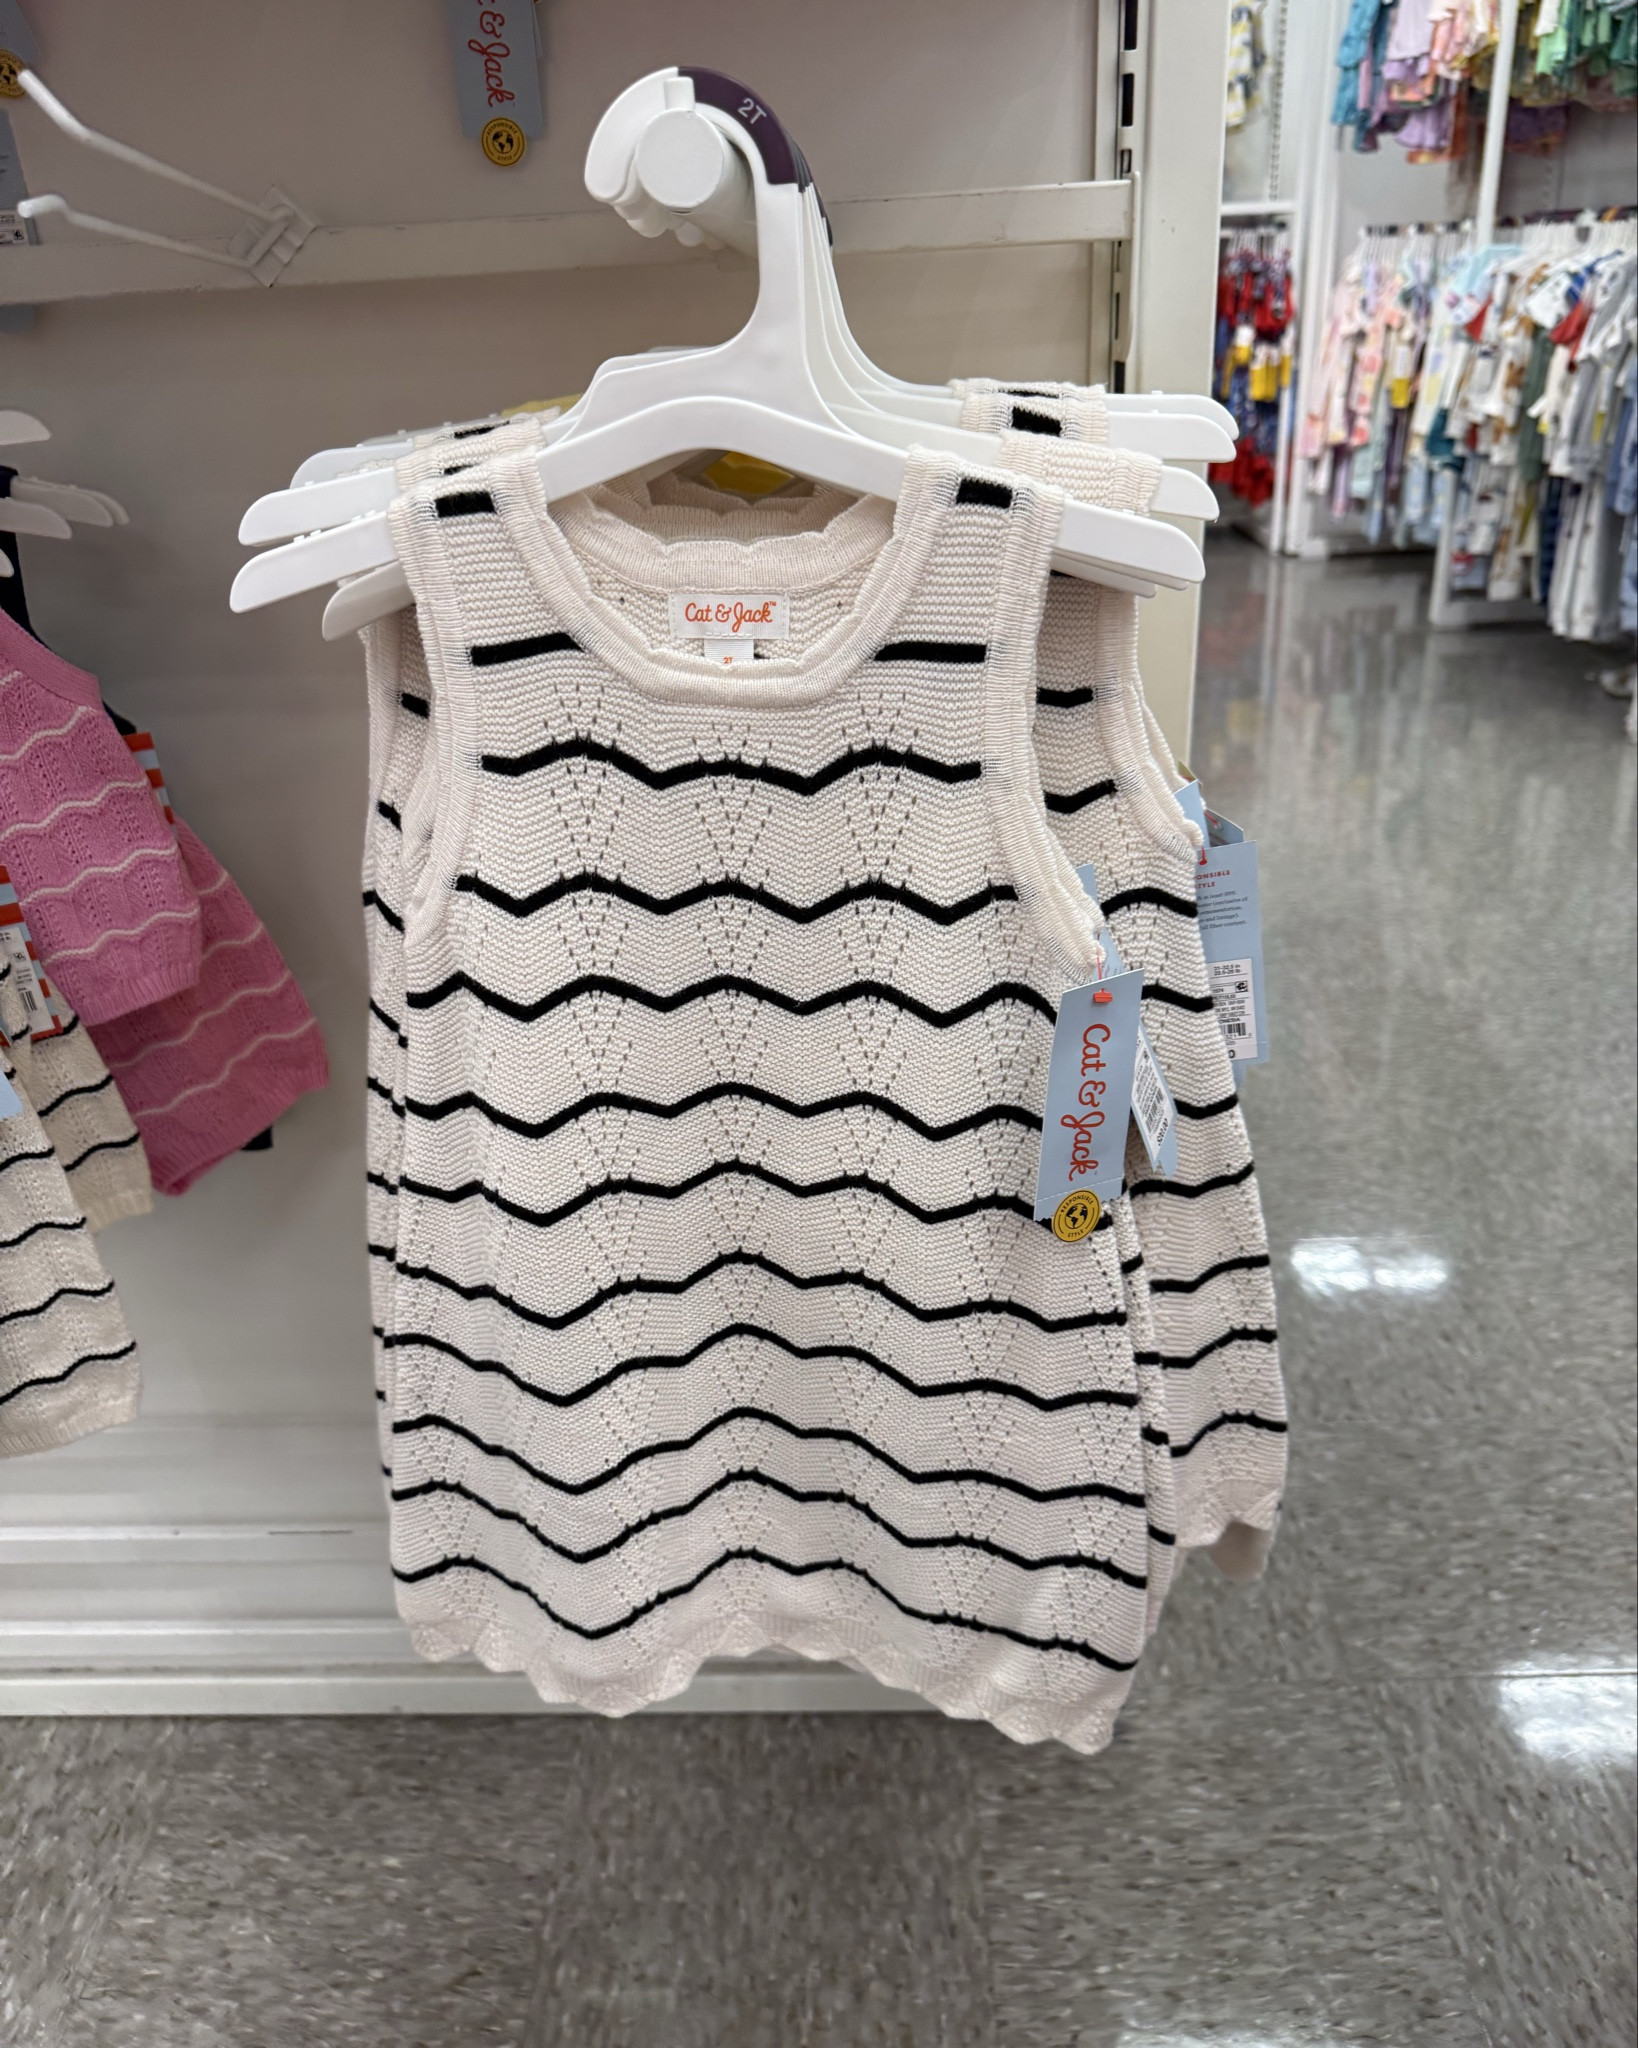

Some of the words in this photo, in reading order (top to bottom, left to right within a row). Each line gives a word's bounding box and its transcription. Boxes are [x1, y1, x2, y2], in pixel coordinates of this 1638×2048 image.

[479, 10, 505, 39] &
[467, 39, 515, 108] Jack
[737, 97, 767, 125] 2T
[684, 602, 713, 623] Cat
[715, 603, 732, 623] &
[731, 601, 774, 633] Jack
[723, 656, 733, 664] 2T
[1195, 870, 1231, 880] ONSIBLE
[1080, 1023, 1111, 1077] Cat
[1078, 1080, 1107, 1108] &
[1060, 1110, 1106, 1182] Jack
[1060, 1194, 1095, 1214] RESPONSIBLE
